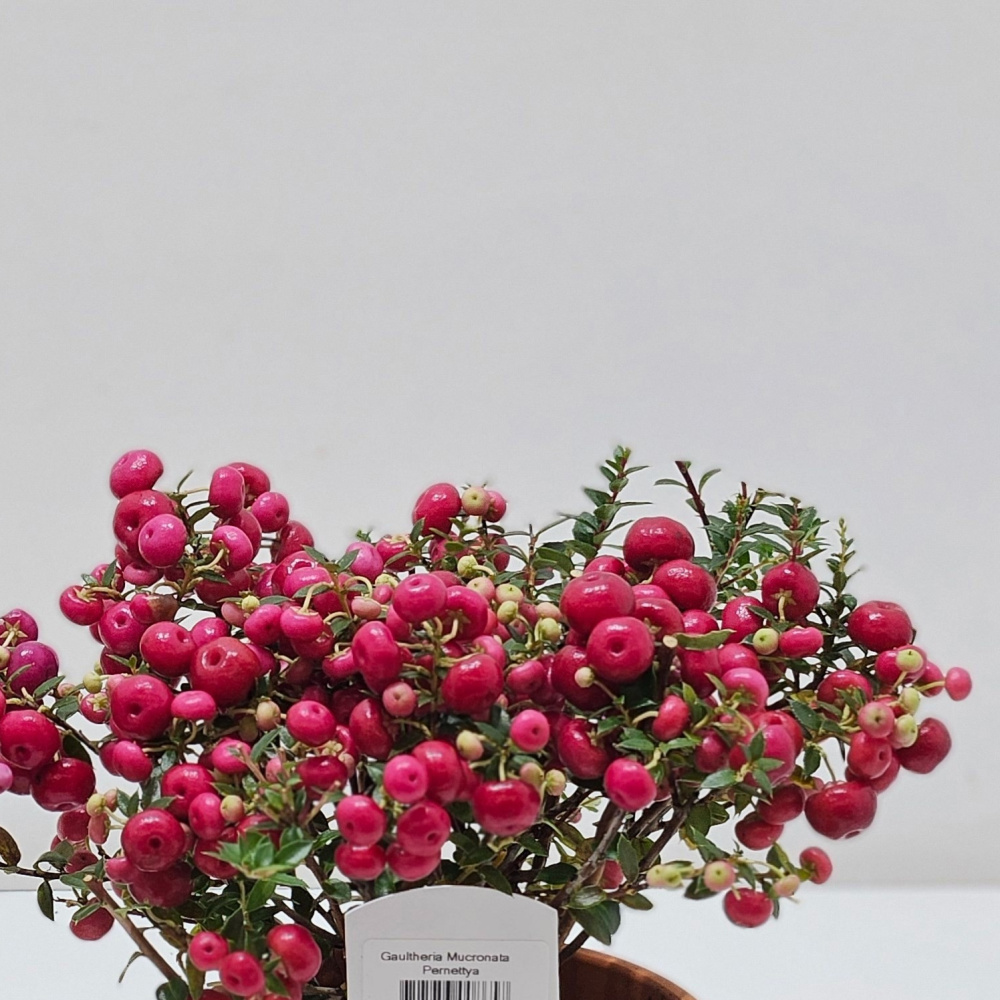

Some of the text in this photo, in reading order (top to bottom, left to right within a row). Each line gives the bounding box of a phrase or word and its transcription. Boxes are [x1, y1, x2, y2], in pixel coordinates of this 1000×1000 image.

[381, 952, 509, 962] Gaultheria Mucronata
[422, 966, 479, 977] Pernettya
